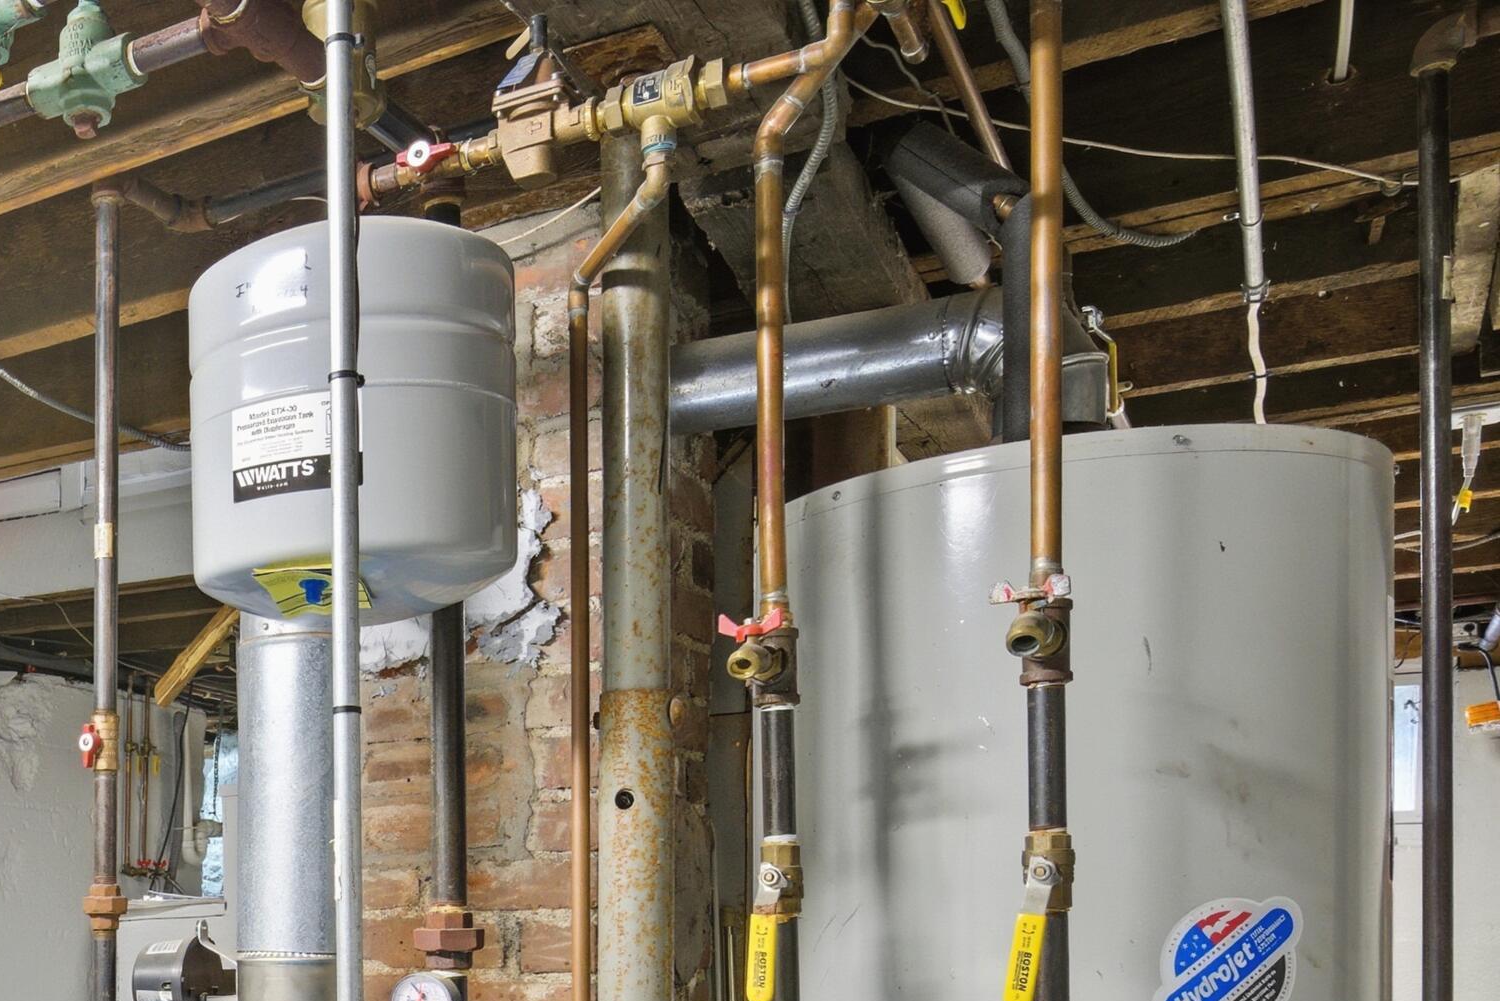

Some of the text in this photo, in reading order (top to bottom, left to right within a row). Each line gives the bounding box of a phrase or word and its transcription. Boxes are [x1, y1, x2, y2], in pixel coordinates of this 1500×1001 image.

[235, 459, 315, 488] WATTS
[757, 952, 767, 989] BOSTON
[1018, 952, 1032, 992] BOSTON
